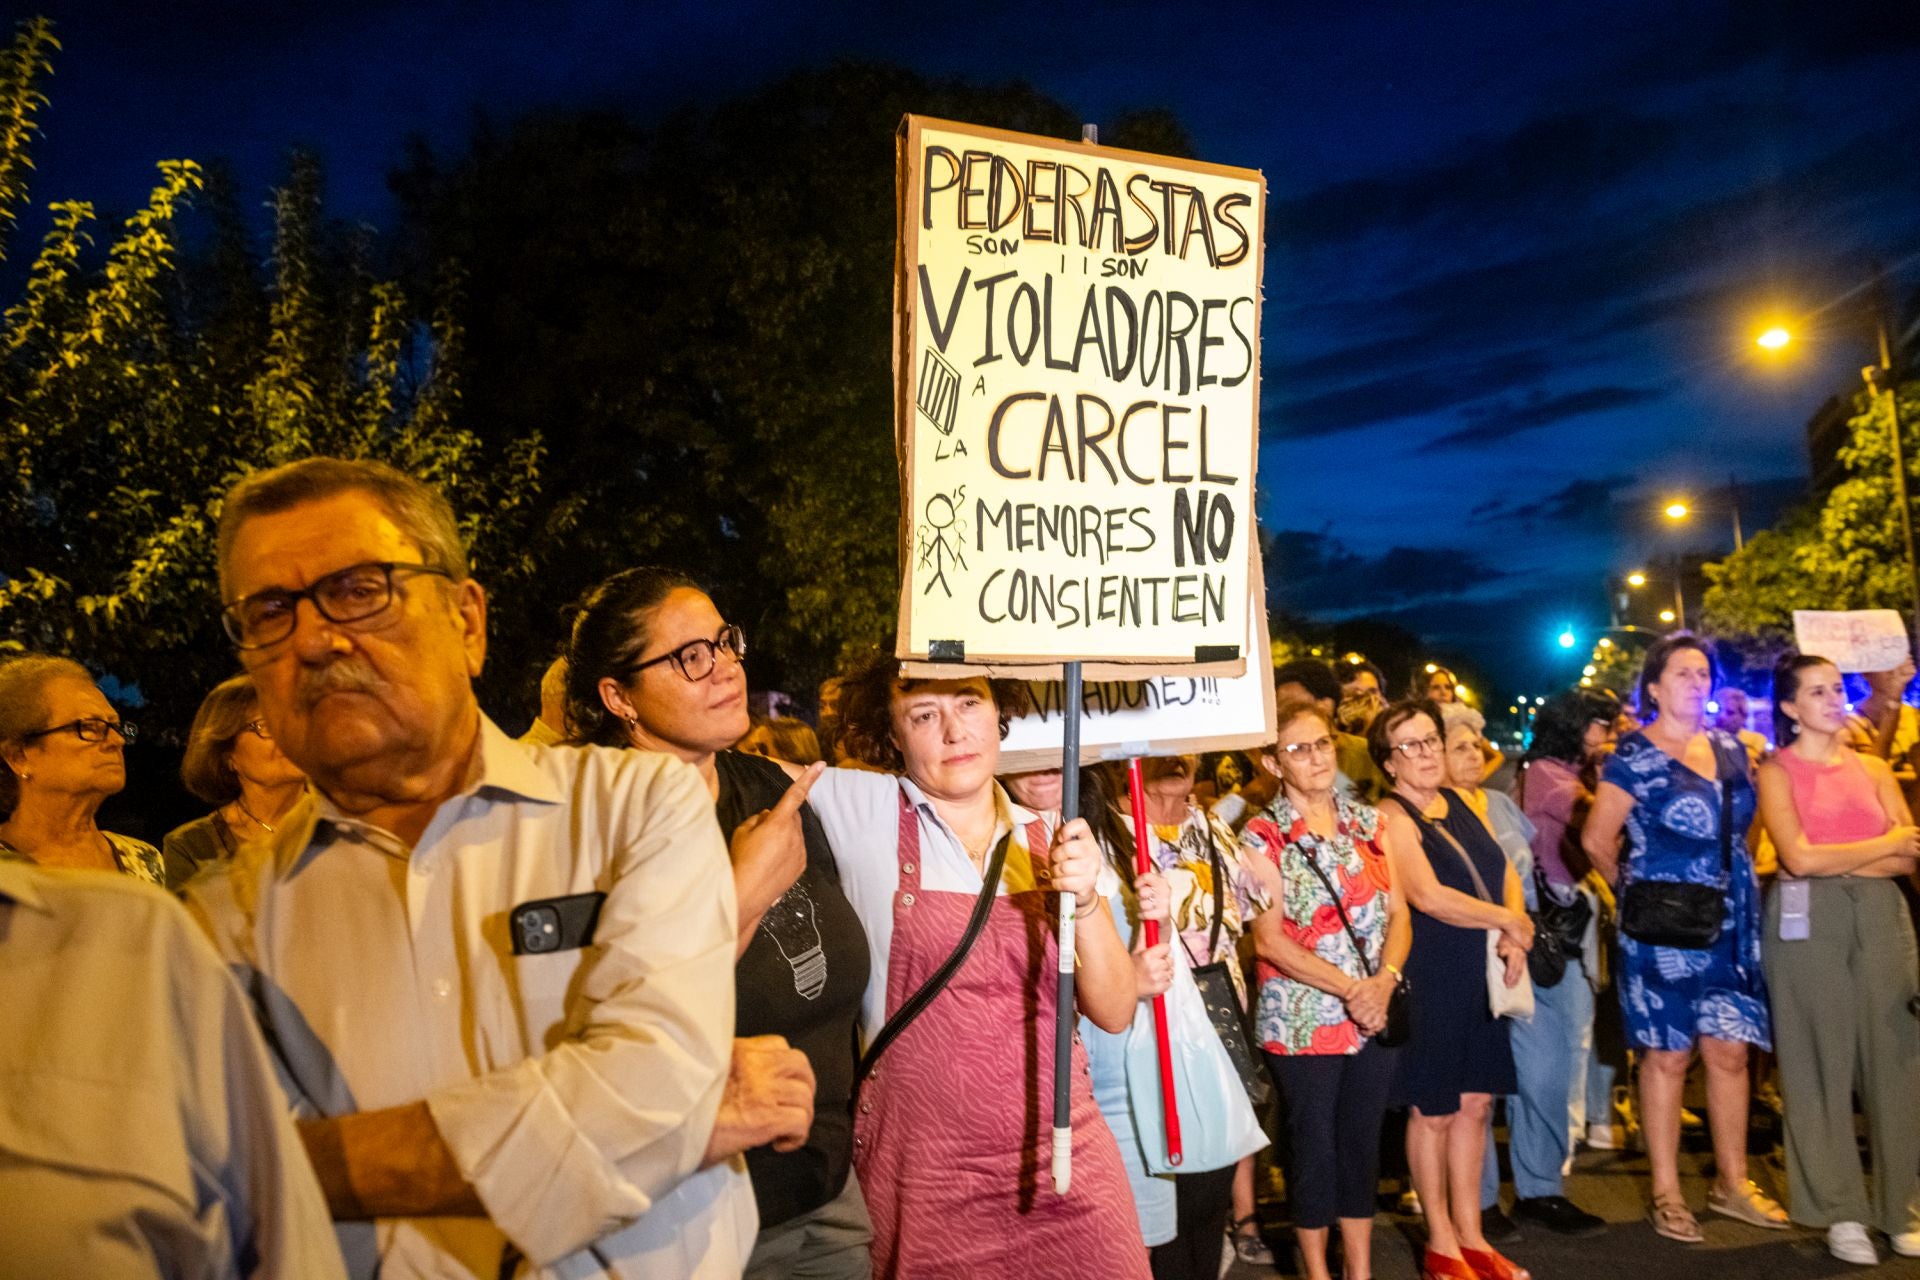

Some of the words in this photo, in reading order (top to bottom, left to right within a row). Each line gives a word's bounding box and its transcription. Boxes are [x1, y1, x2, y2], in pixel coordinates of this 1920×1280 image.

[923, 145, 1252, 270] PEDERASTAS
[966, 234, 1020, 256] SON
[1100, 257, 1149, 280] SON
[918, 263, 1255, 396] VIOLADORES
[972, 374, 986, 397] A
[935, 439, 968, 461] LA
[987, 390, 1239, 486] CARCEL
[976, 497, 1156, 565] MENORES
[1173, 487, 1235, 567] NO
[978, 568, 1226, 629] CONSIENTEN
